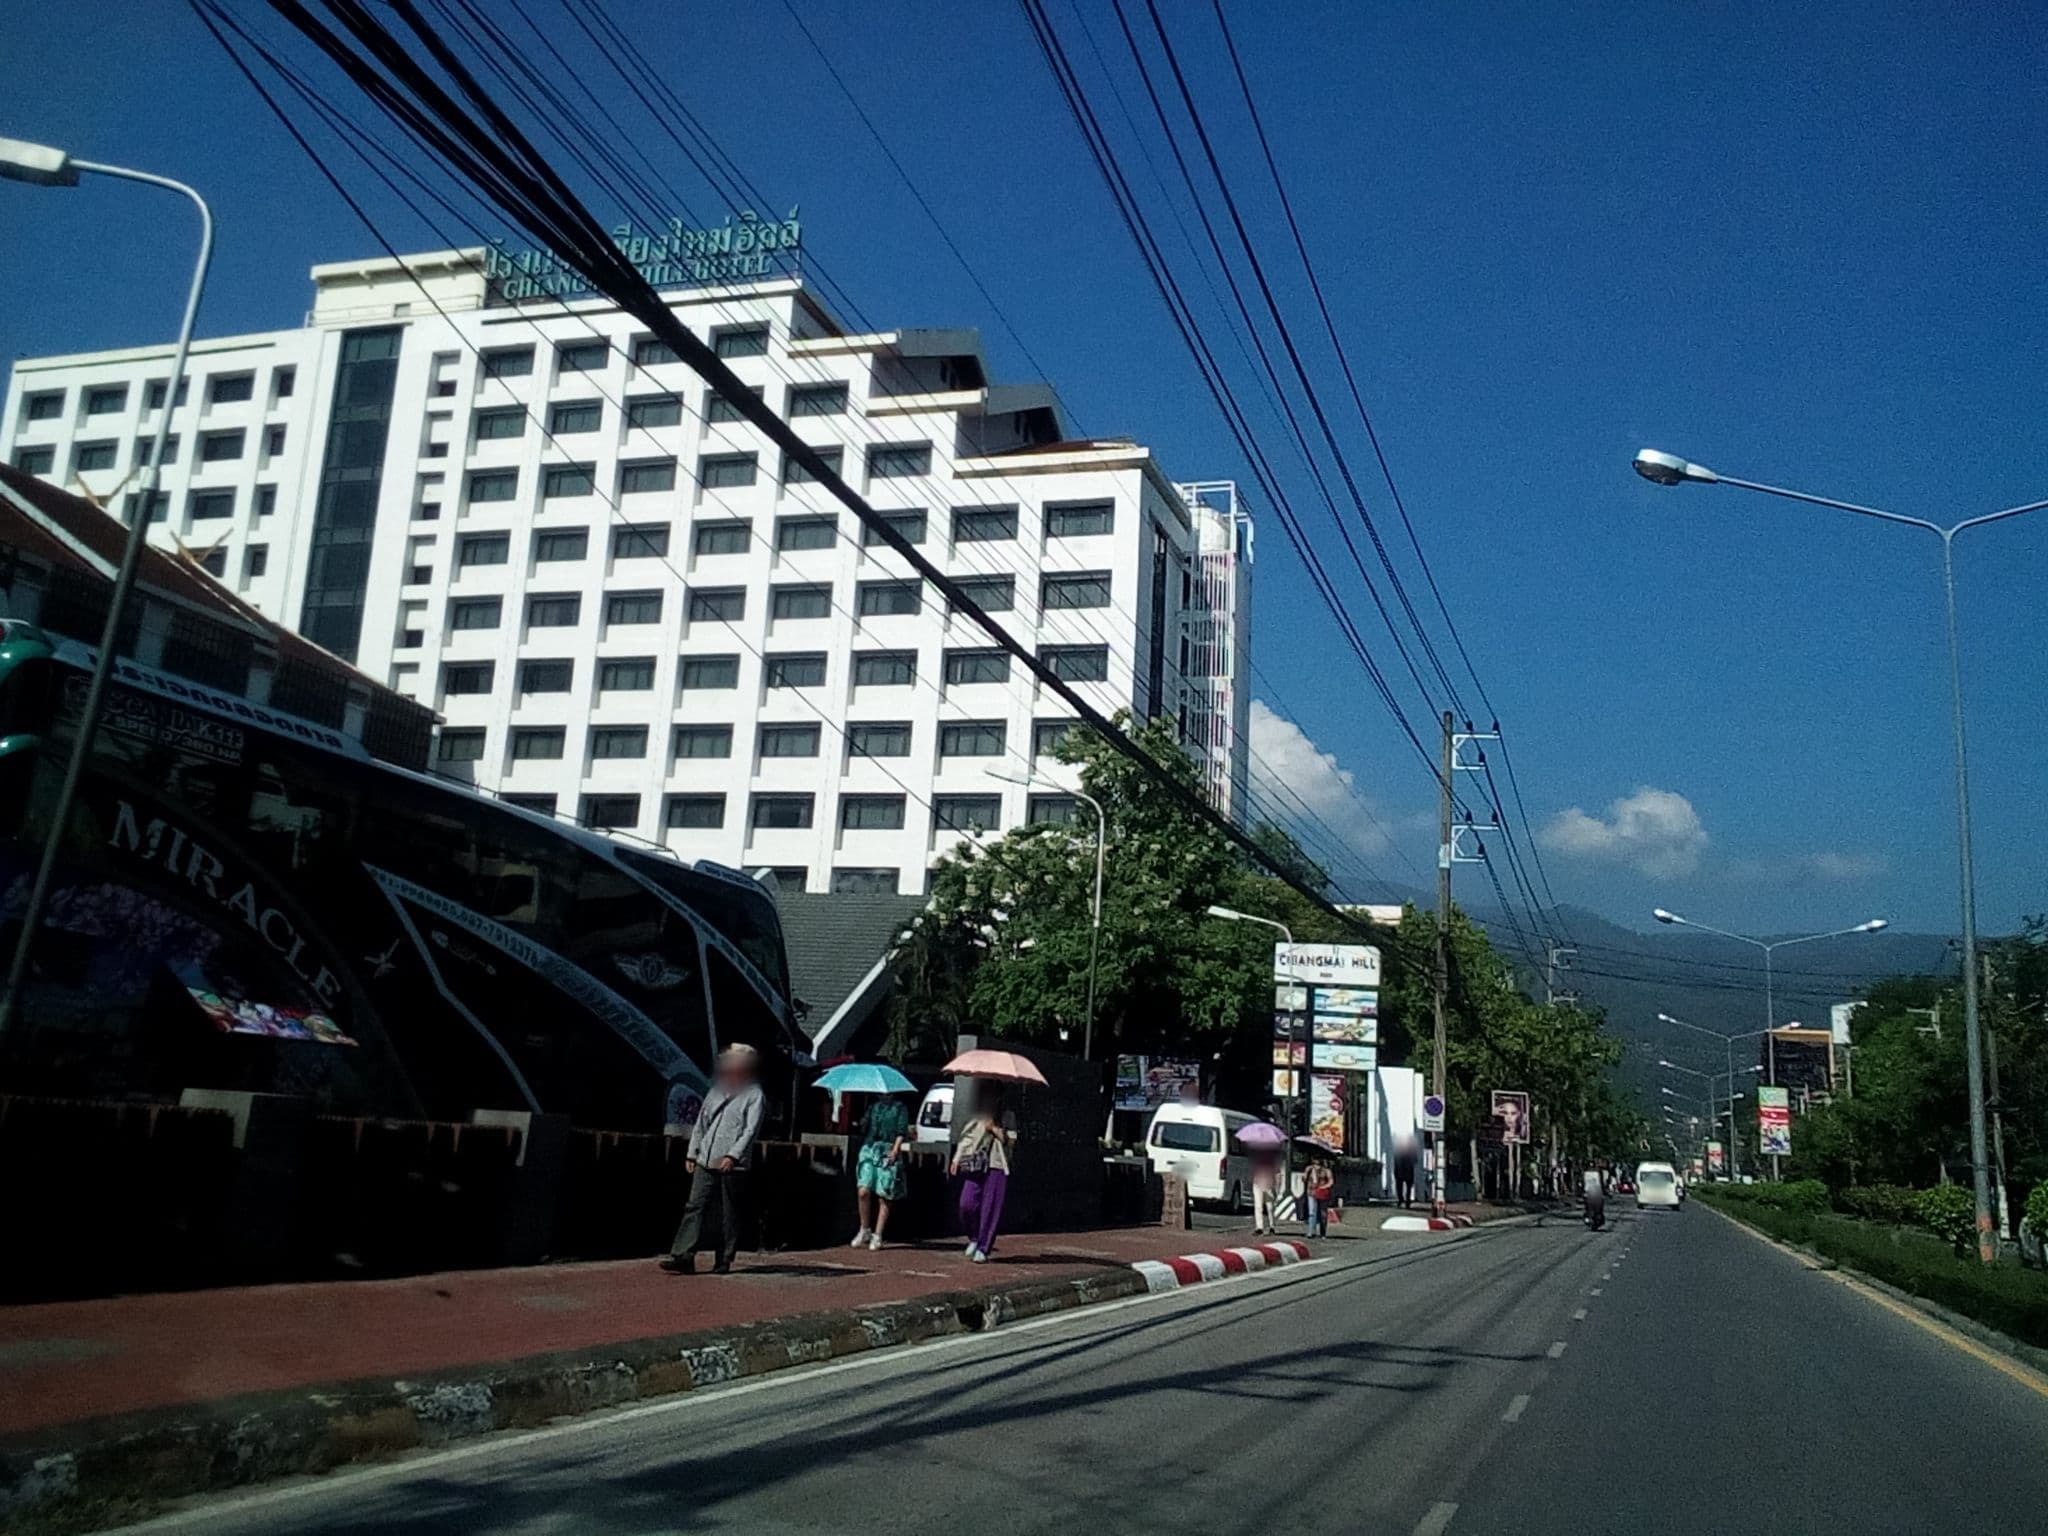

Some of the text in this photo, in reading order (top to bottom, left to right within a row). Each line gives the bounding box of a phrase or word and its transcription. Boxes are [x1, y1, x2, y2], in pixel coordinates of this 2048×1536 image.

[694, 256, 773, 280] HOTEL
[107, 800, 342, 1010] MIRACLE
[1352, 957, 1377, 970] HILL
